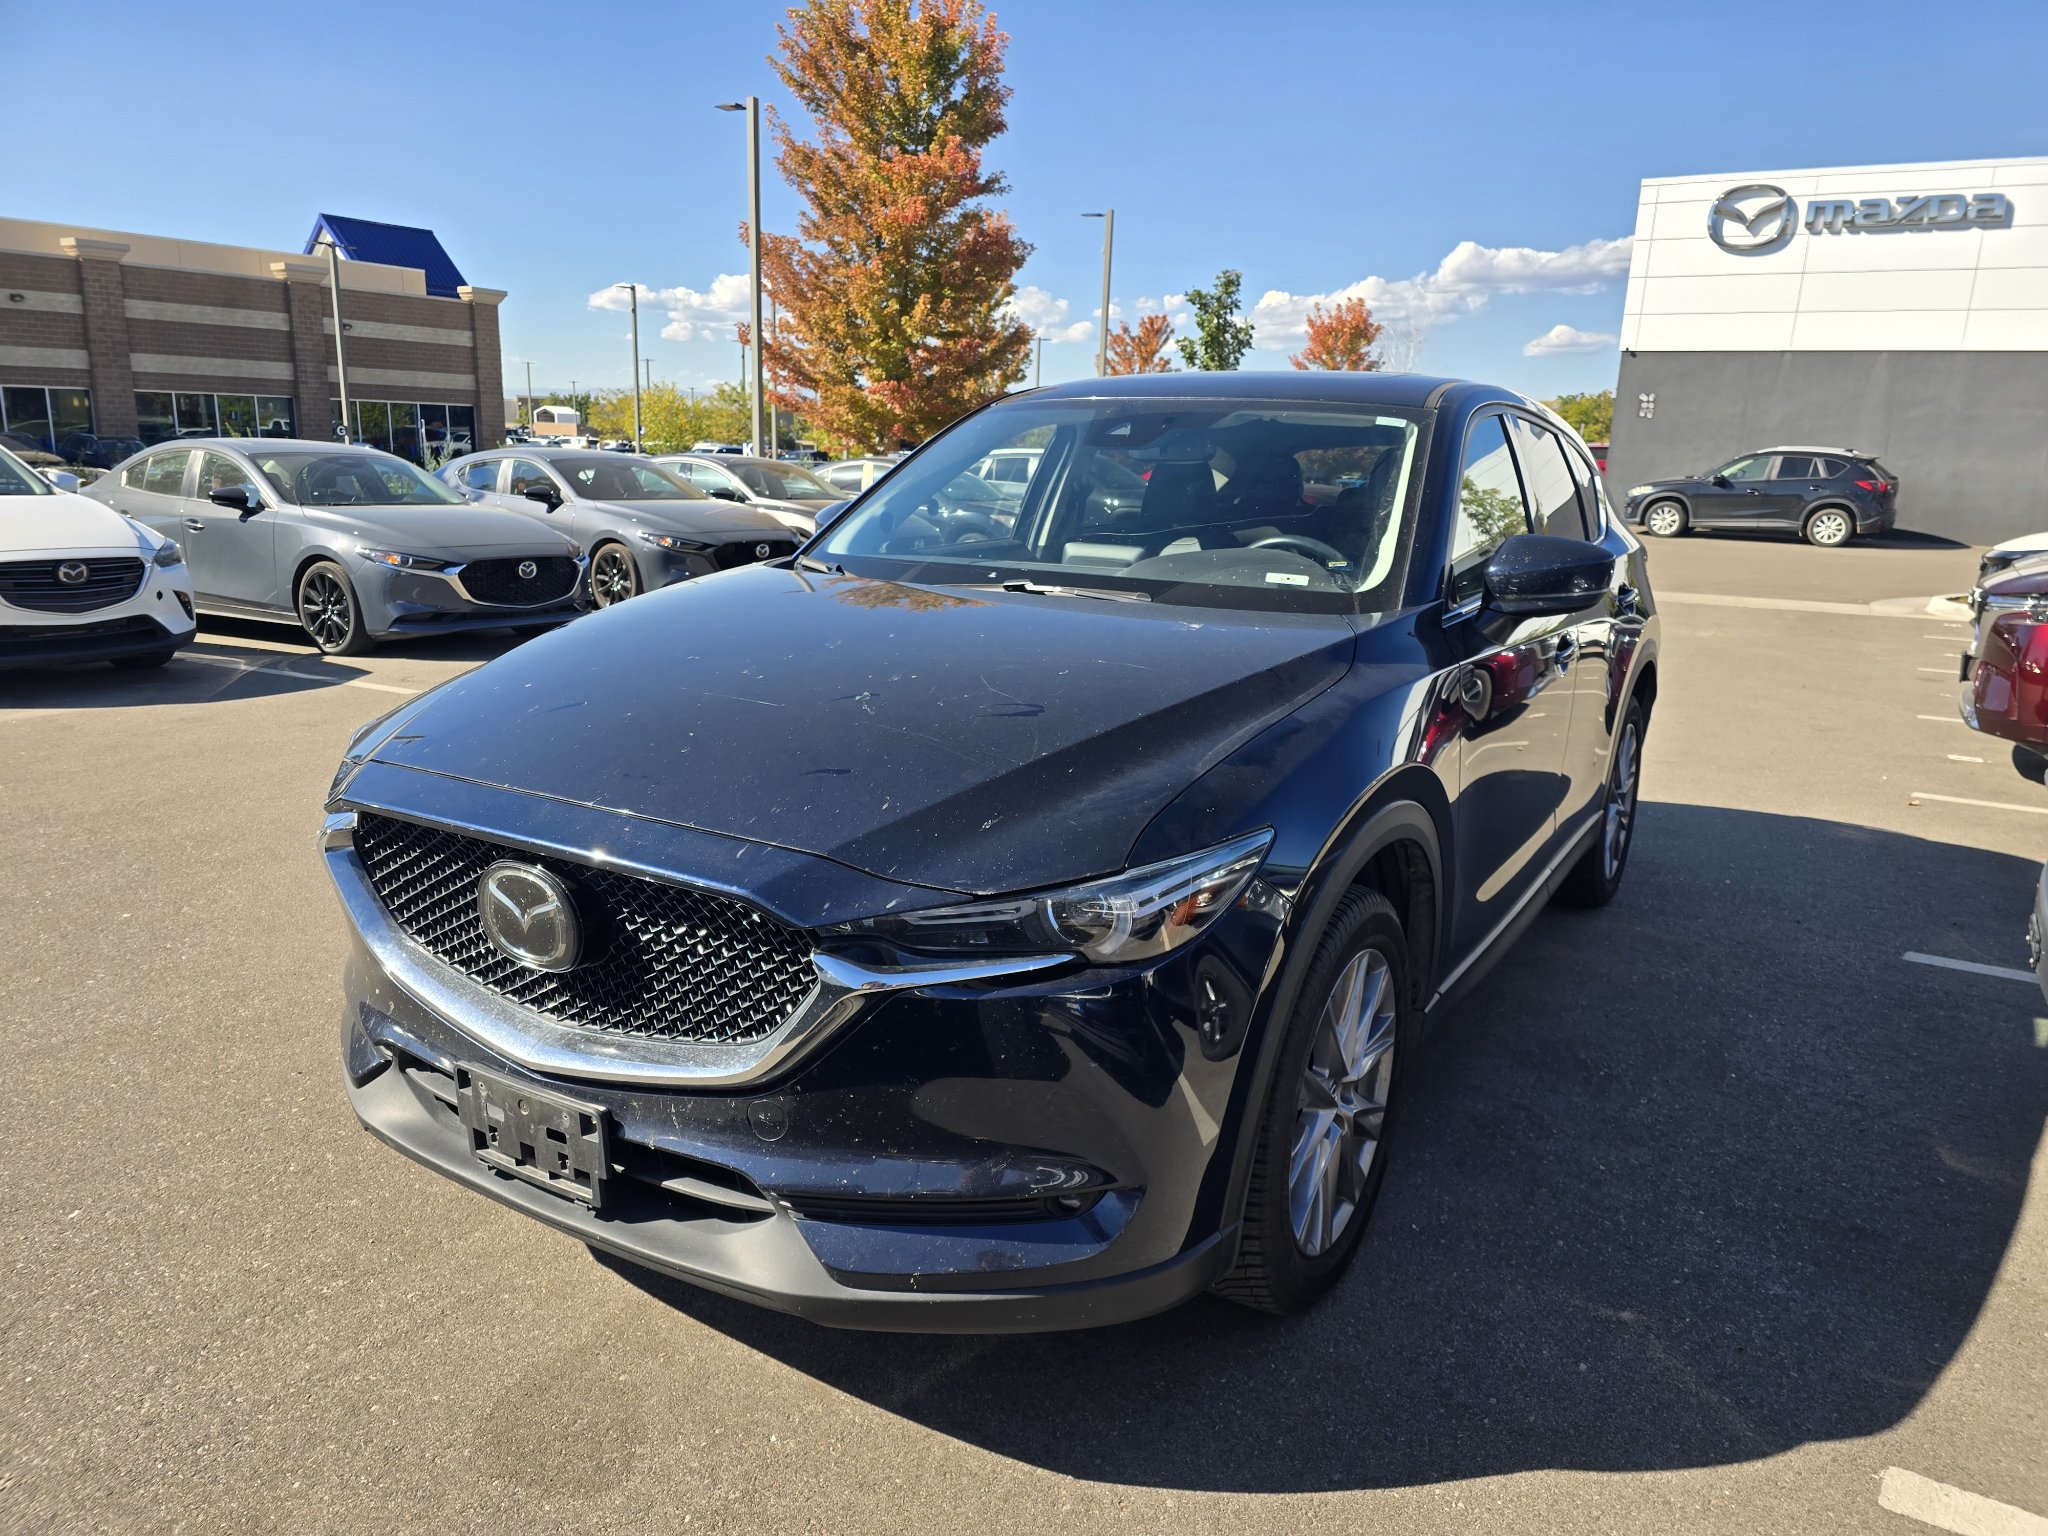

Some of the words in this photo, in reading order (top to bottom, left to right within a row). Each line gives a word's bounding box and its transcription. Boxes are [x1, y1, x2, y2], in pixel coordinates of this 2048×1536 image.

[1805, 193, 2009, 229] mazda
[336, 425, 346, 436] G
[742, 442, 754, 458] K
